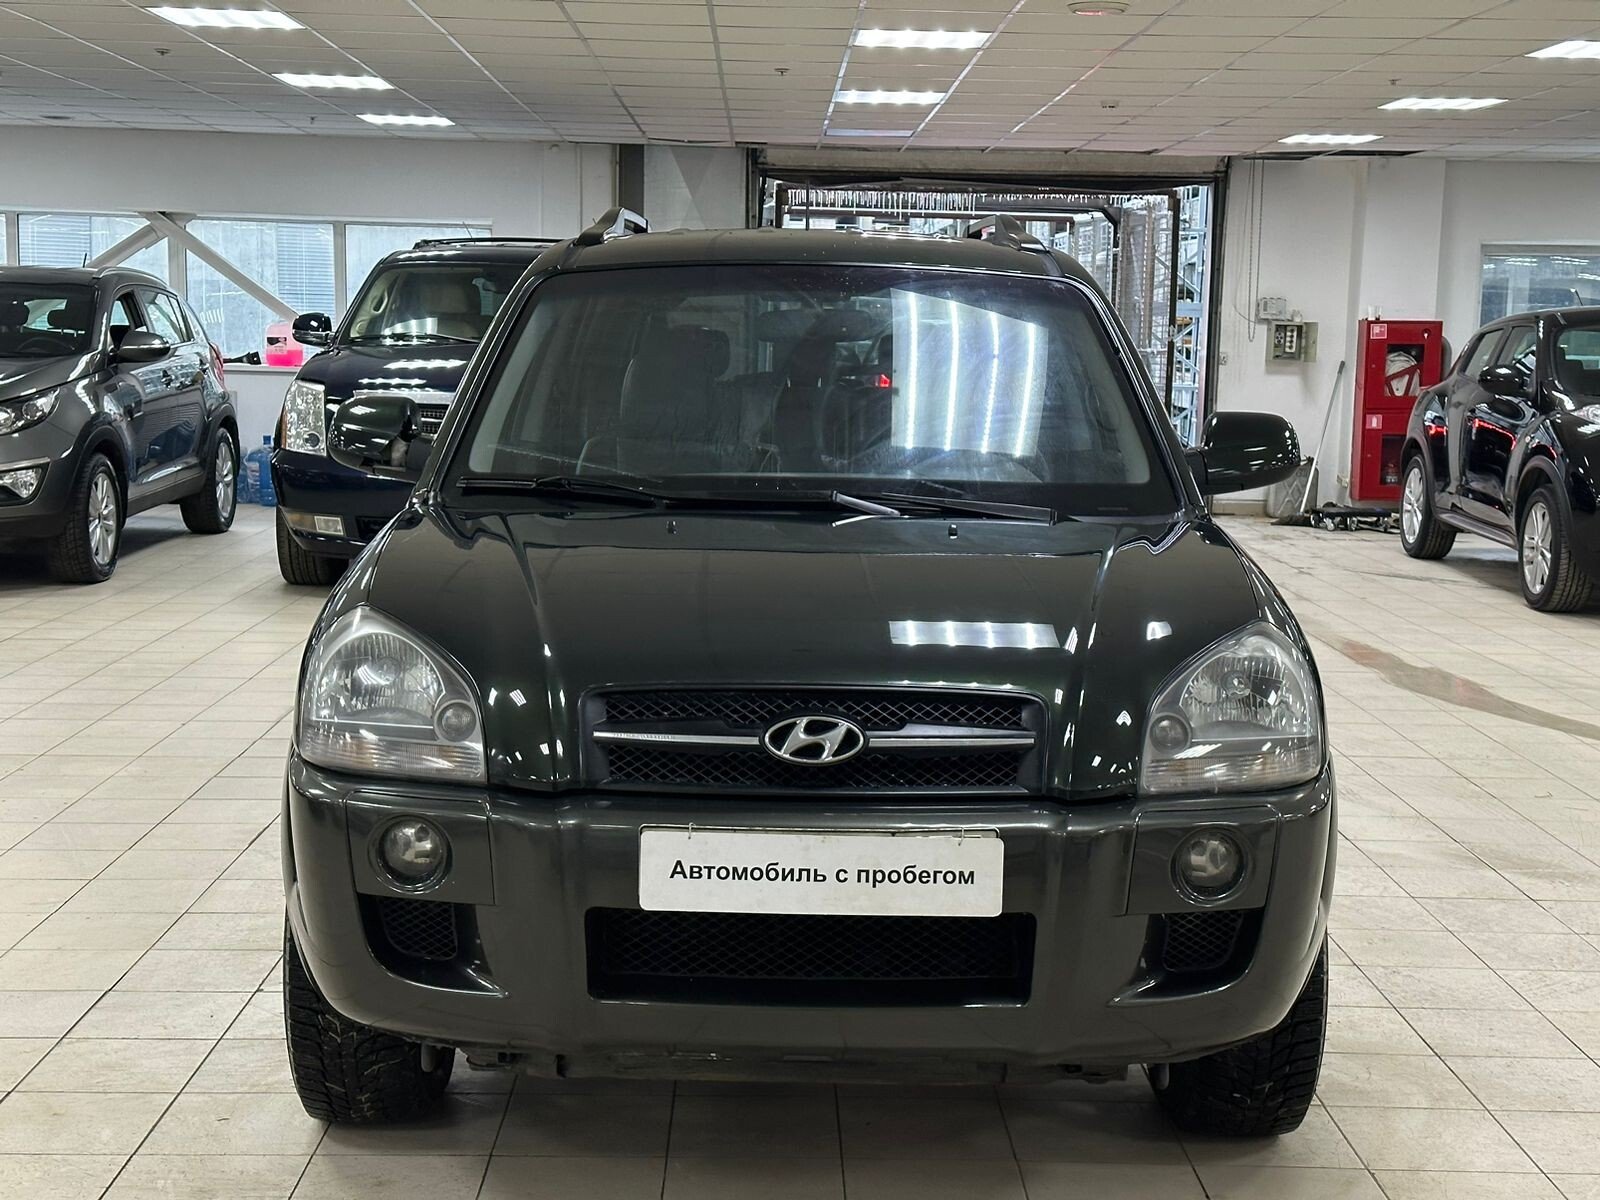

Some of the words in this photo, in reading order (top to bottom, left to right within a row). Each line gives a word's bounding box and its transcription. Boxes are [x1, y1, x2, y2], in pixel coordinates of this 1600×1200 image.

[669, 859, 827, 883] Автомобиль
[835, 868, 849, 884] с
[856, 864, 976, 889] пробегом
